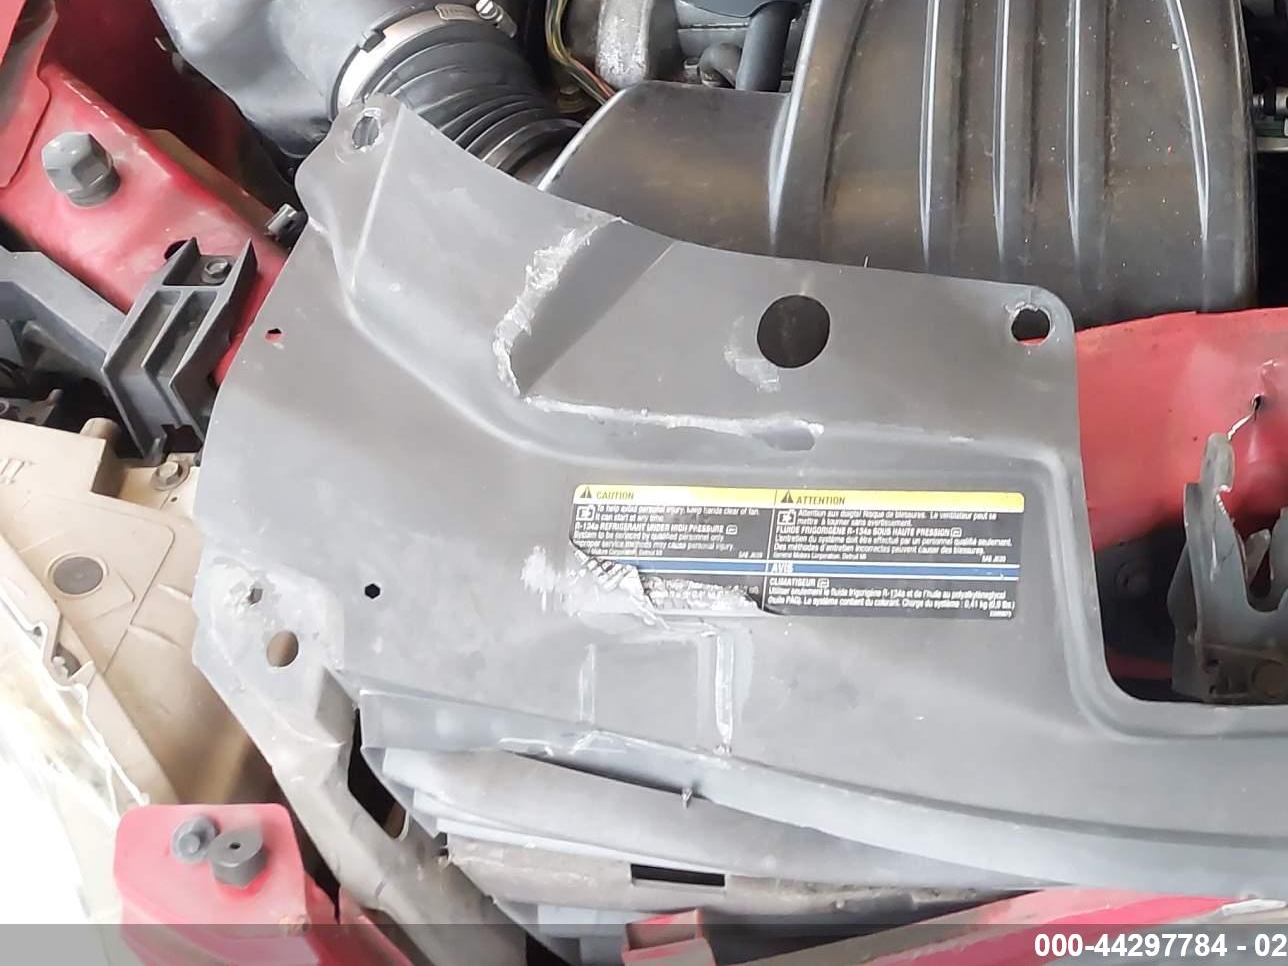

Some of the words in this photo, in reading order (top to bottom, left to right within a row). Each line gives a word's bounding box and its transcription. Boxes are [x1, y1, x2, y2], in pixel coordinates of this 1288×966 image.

[596, 491, 634, 500] CAUTION
[796, 496, 846, 505] ATTENTION
[723, 507, 740, 515] clear
[740, 508, 748, 516] of
[930, 512, 939, 520] Le
[600, 513, 613, 521] can
[613, 514, 629, 522] start
[575, 521, 600, 531] R-134a
[600, 522, 647, 532] REFRIGERANT
[647, 523, 671, 532] UNDER
[670, 523, 688, 532] HIGH
[688, 524, 725, 533] PRESSURE
[776, 525, 801, 534] FLUIDE
[846, 527, 872, 536] R-134a
[872, 527, 892, 536] SOUS
[892, 528, 915, 537] HAUTE
[915, 528, 951, 537] PRESSION
[900, 538, 912, 546] par
[774, 543, 787, 551] Des
[771, 562, 793, 573] AVIS
[769, 578, 816, 587] CLIMATISEUR
[905, 589, 914, 597] et
[914, 589, 923, 598] de
[942, 590, 951, 598] au
[803, 596, 812, 605] Le
[979, 599, 988, 611] kg
